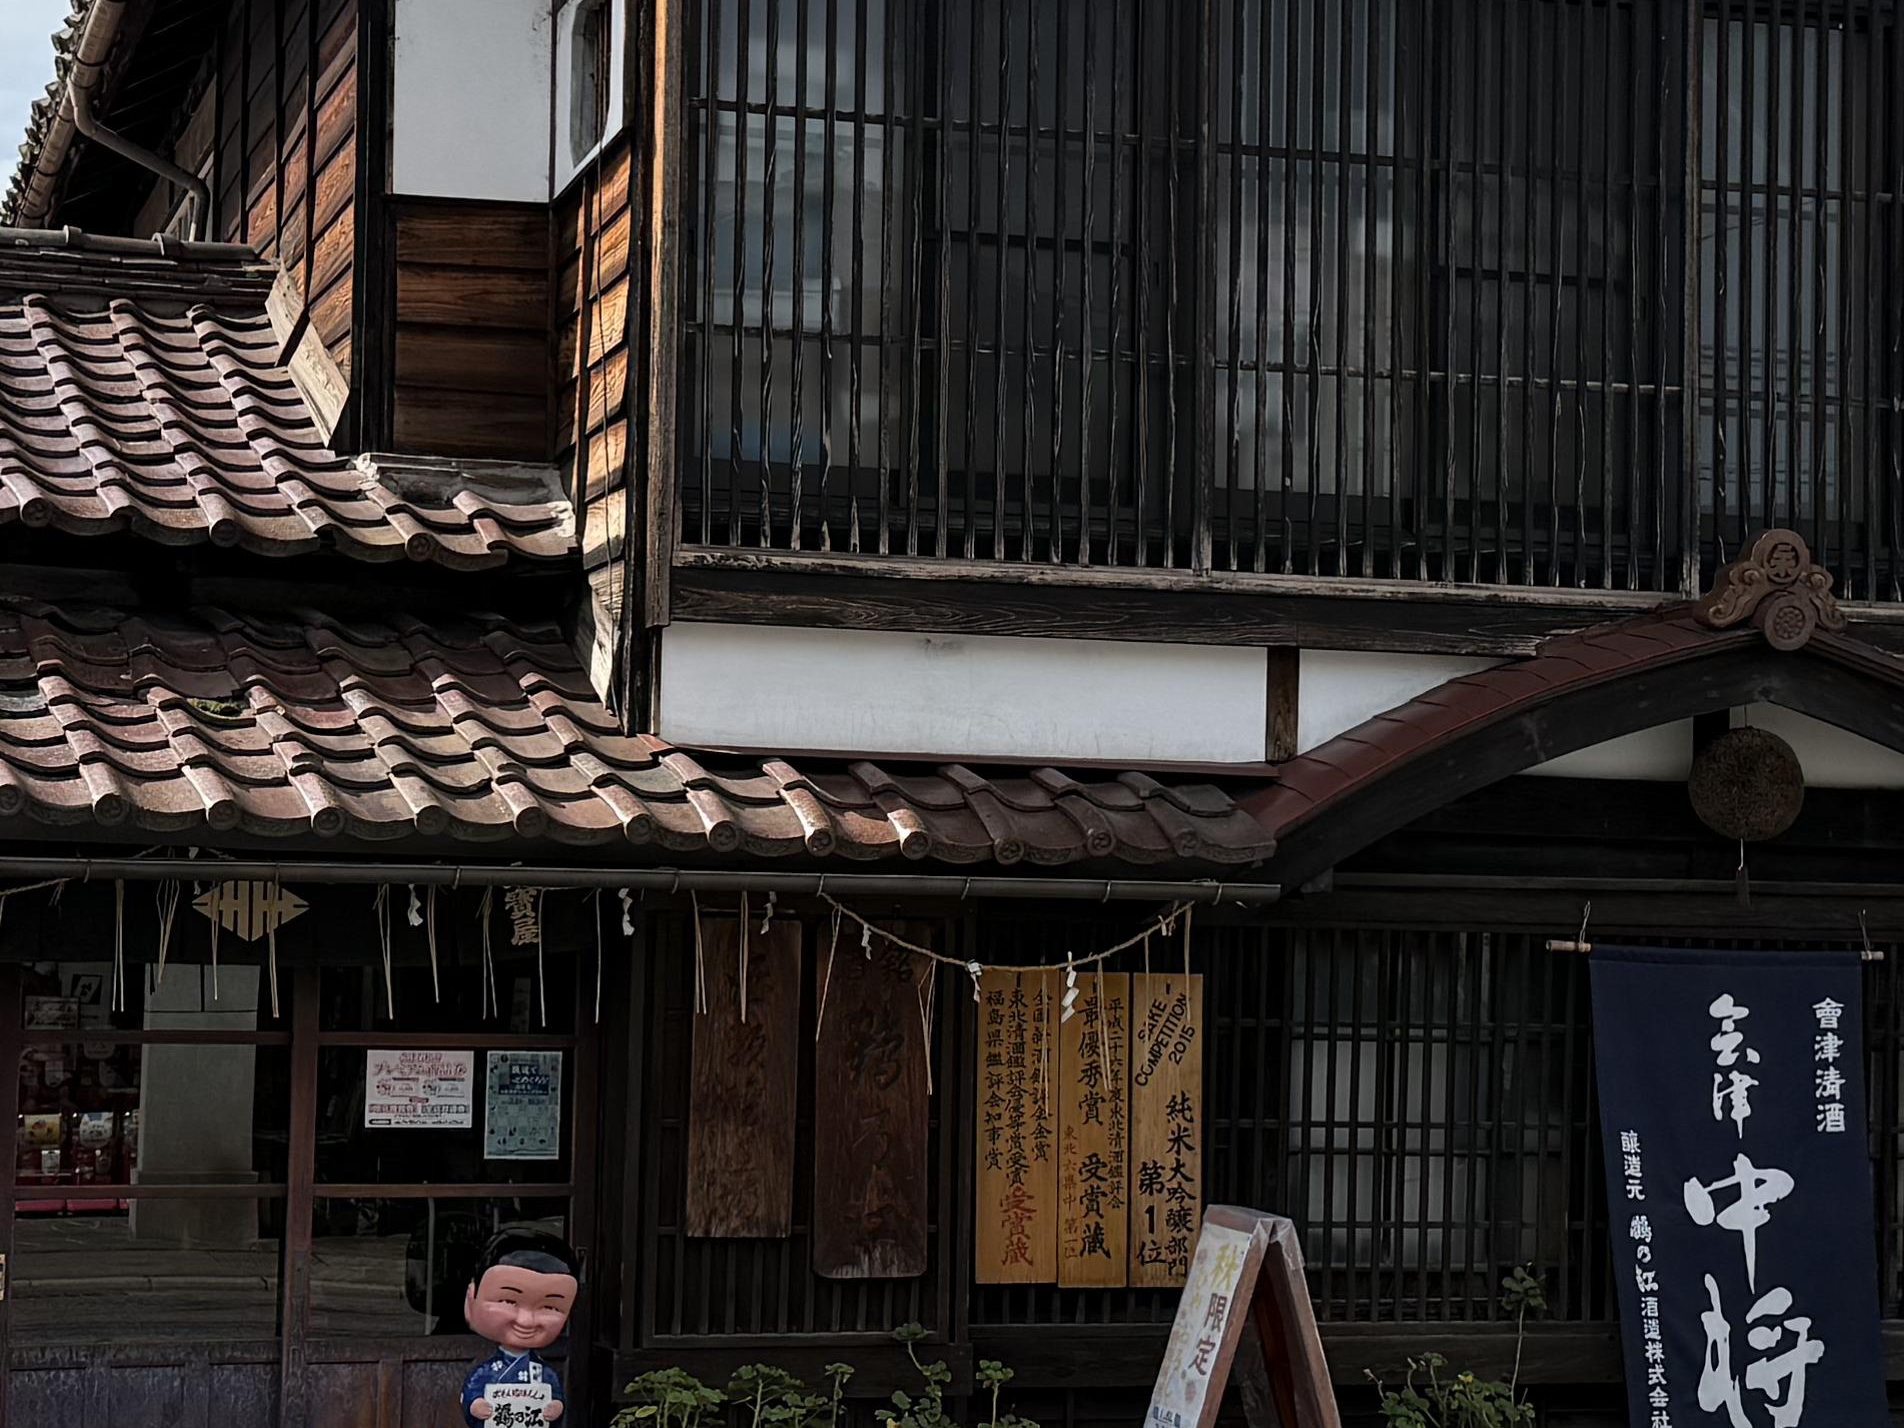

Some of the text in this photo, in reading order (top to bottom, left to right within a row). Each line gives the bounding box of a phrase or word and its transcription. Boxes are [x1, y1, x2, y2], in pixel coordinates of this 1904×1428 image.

[984, 990, 1006, 1171] 福島県鑑評会知事賞
[1004, 988, 1030, 1188] 東北清酒鑑評会優等賞受賞
[1134, 992, 1189, 1087] COMPETITION
[1137, 997, 1168, 1044] SAKE
[1168, 1024, 1196, 1066] 2015
[1811, 996, 1847, 1134] 會津清酒
[1077, 995, 1112, 1259] 最優秀賞 受賞蔵
[1106, 997, 1125, 1210] 平成二十六年度東北清酒鑑評会
[1620, 1129, 1646, 1201] 醸造元
[999, 1187, 1037, 1267] 受賞蔵
[1062, 1124, 1079, 1259] 東北六県中 第一位
[1136, 1159, 1167, 1267] 第1位
[1165, 1090, 1197, 1278] 純米大吟醸部門
[1187, 1242, 1242, 1377] 秋限定
